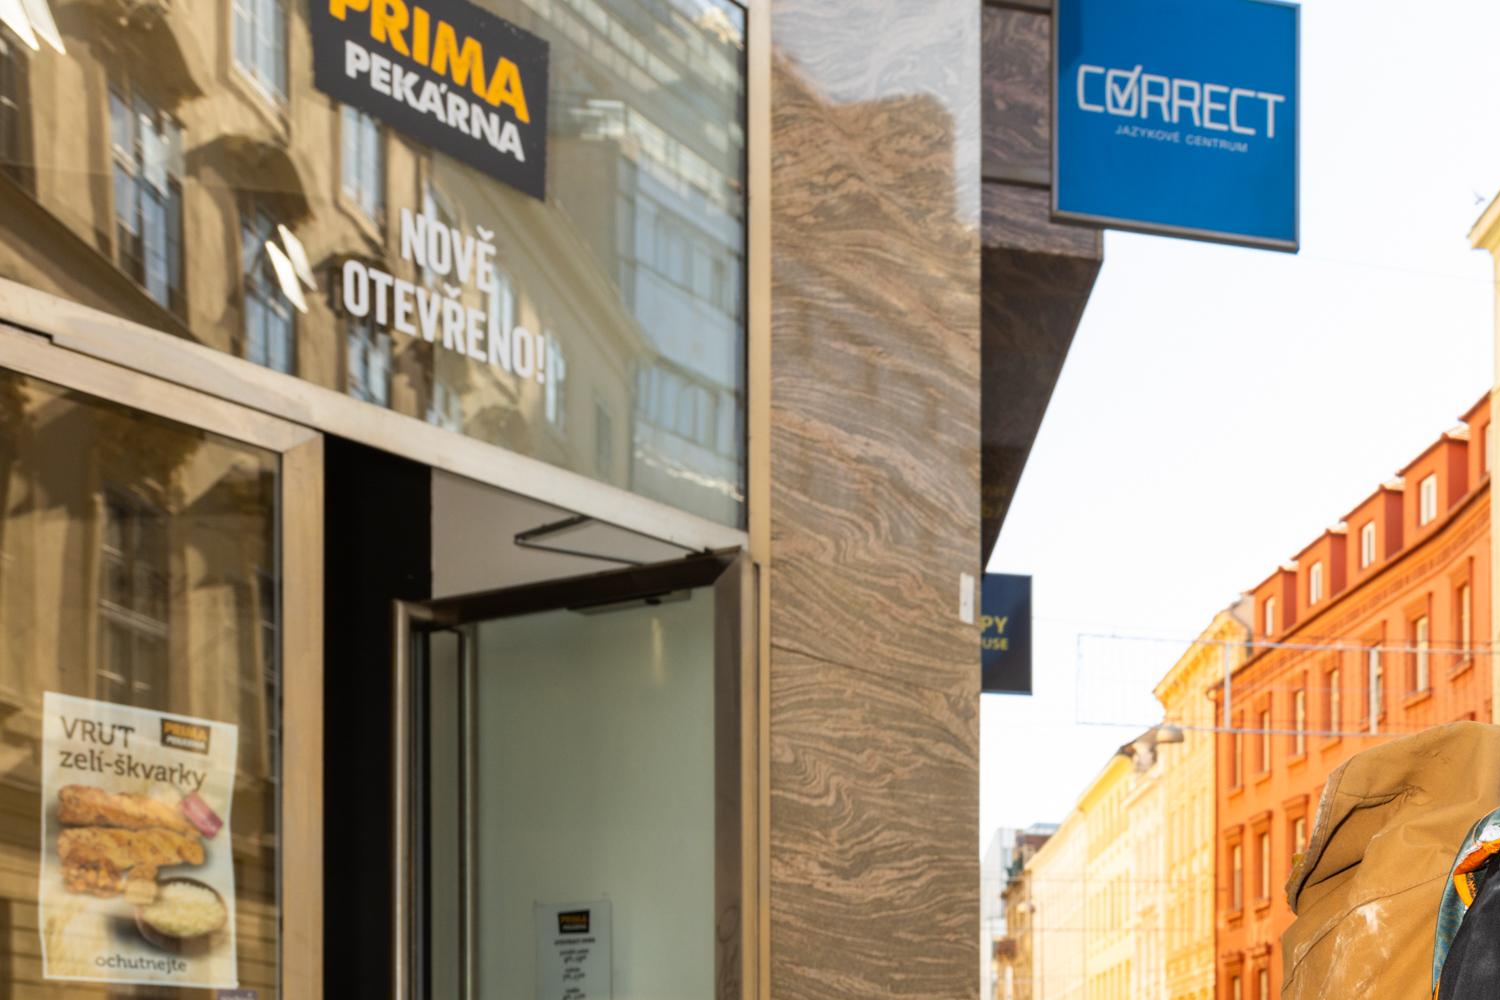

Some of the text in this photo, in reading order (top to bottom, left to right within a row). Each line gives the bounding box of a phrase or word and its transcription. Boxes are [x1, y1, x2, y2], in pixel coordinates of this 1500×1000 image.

[345, 40, 525, 162] PEKÁRNA
[1077, 64, 1286, 138] CORRECT
[1115, 125, 1249, 153] JAZYKOVÉ CENTRUM
[401, 207, 497, 295] NOVĚ
[343, 258, 545, 384] OTEVŘENO!
[60, 715, 135, 749] VRUT
[59, 749, 207, 792] zelí-škvarky
[95, 954, 188, 975] ochutnejte
